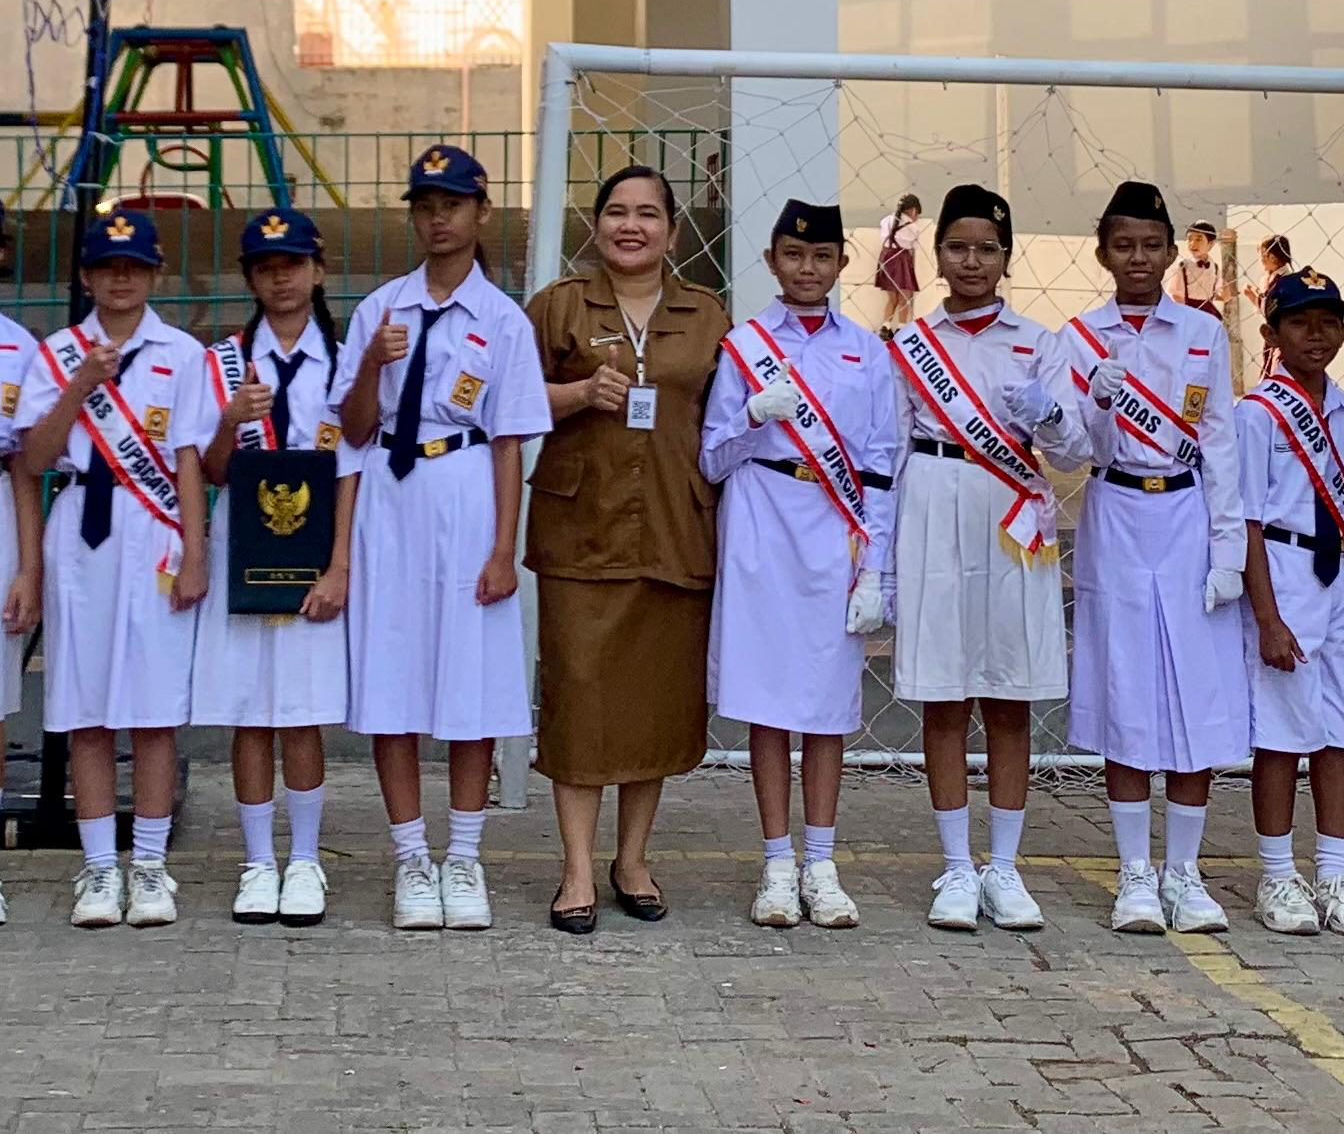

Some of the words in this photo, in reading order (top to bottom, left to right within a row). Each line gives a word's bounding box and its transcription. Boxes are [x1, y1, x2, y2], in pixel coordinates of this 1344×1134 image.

[57, 343, 113, 420] PEAS
[214, 340, 243, 391] TUGA
[755, 356, 818, 429] PEAS
[902, 333, 959, 404] PETUGAS
[1088, 365, 1162, 434] UGAS
[1264, 382, 1328, 454] PETUGAS
